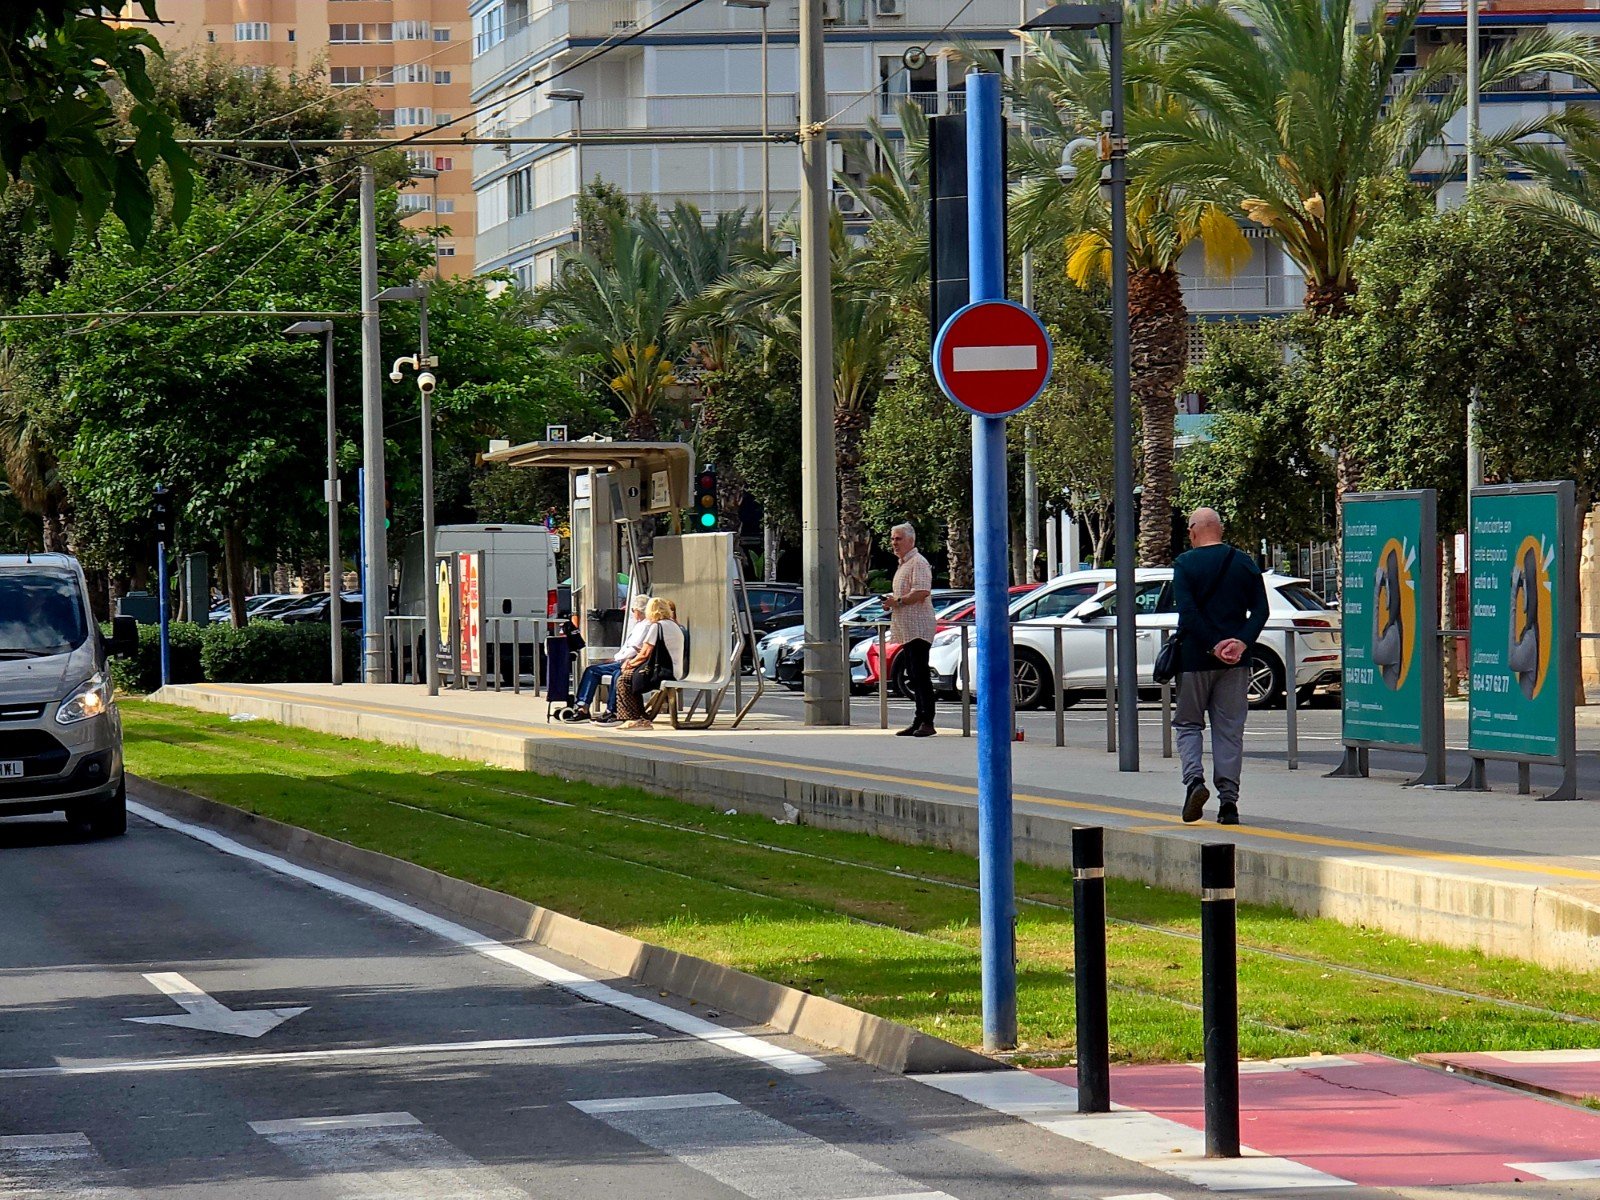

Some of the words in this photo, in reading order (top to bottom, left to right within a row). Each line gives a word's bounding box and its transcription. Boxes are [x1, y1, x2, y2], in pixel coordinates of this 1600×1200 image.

[1485, 674, 1493, 692] 57
[1493, 675, 1502, 693] 62
[1502, 676, 1510, 693] 77
